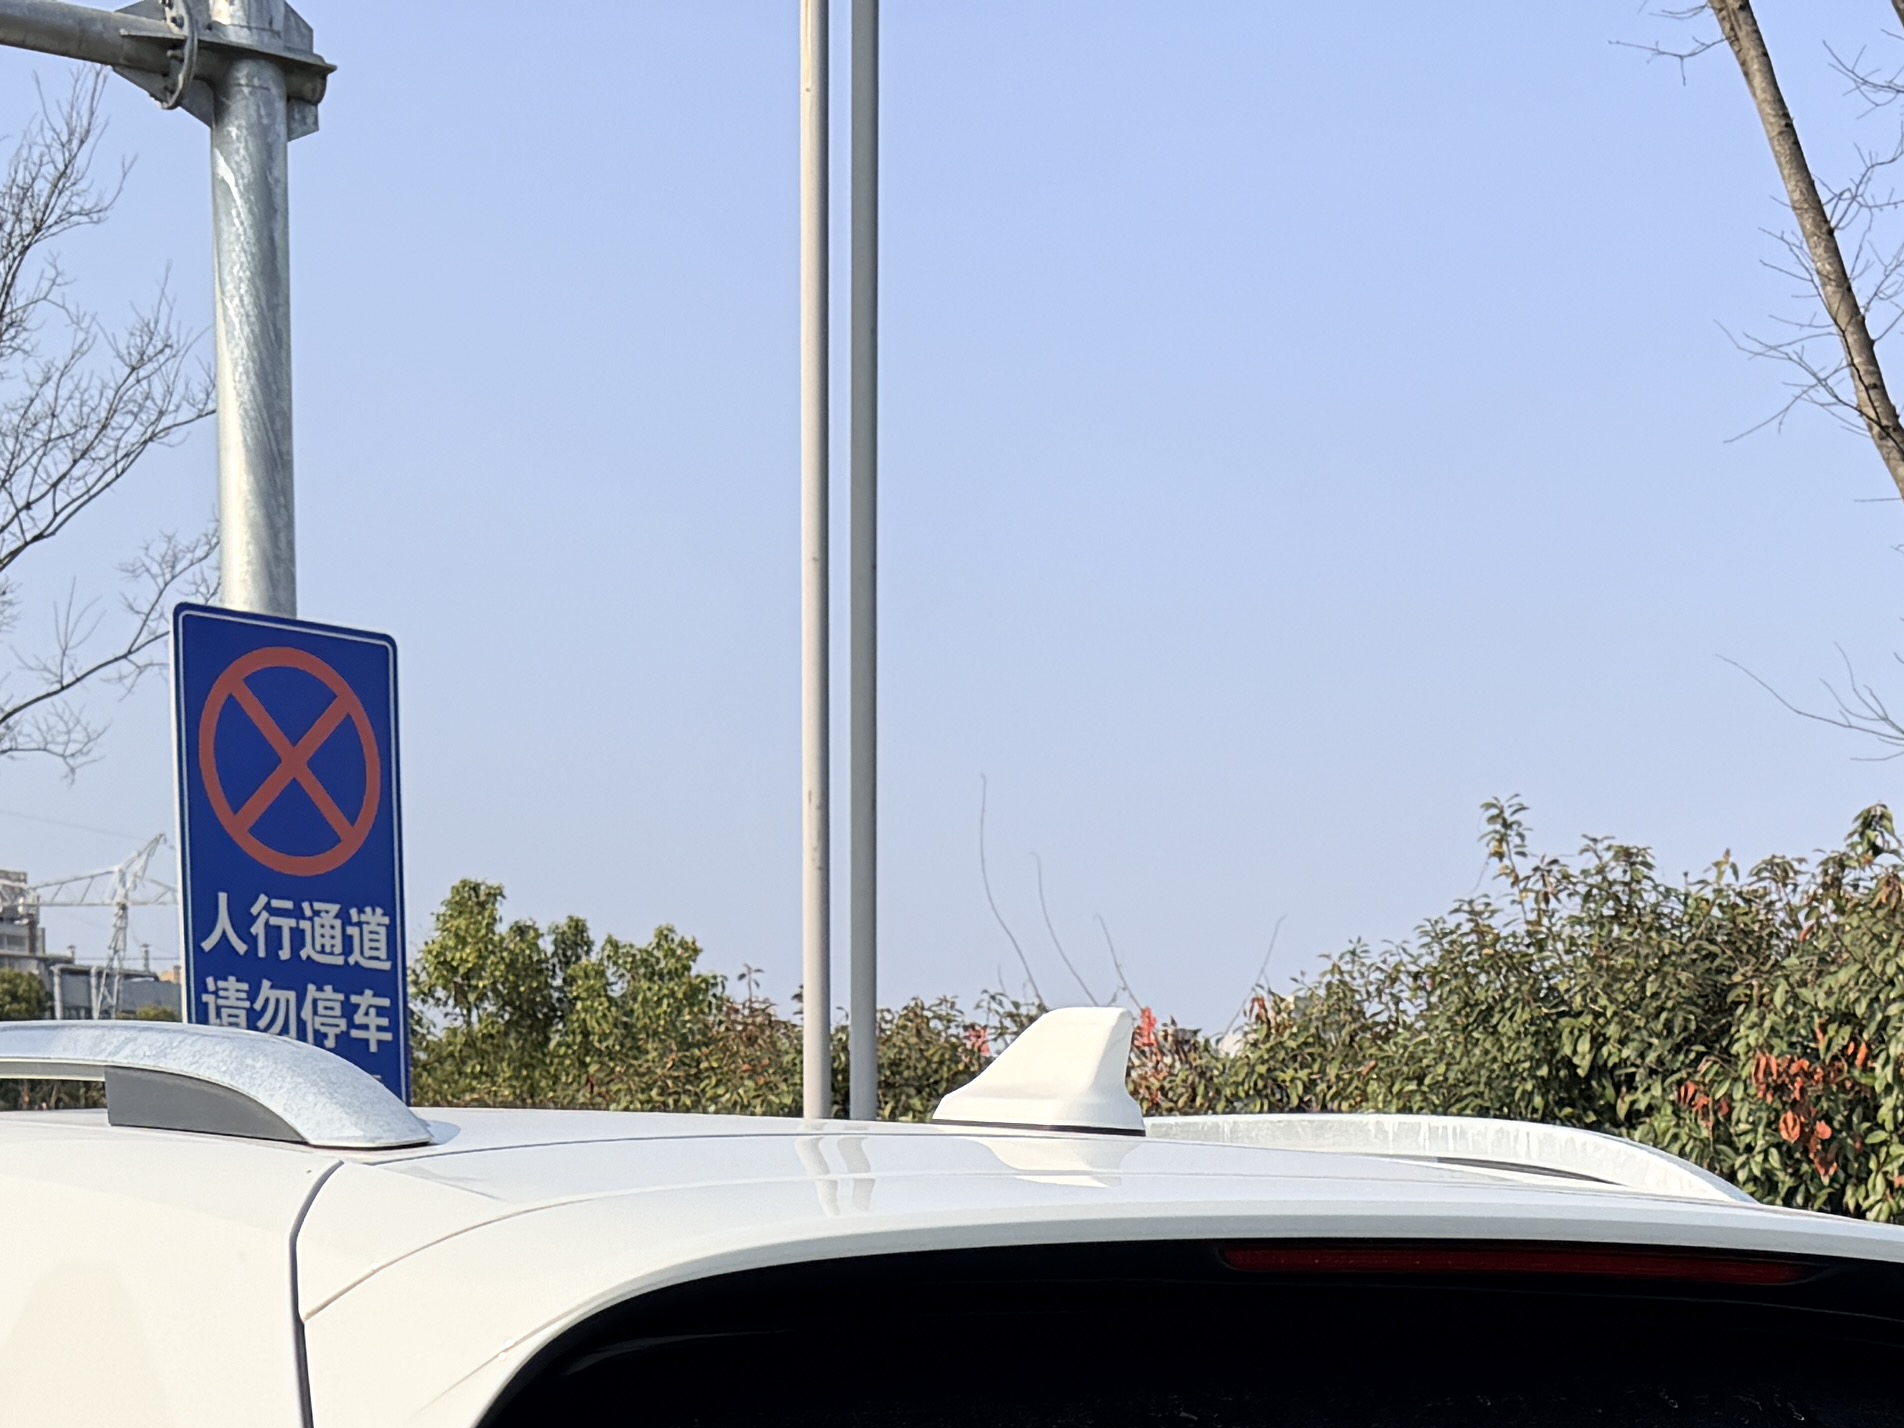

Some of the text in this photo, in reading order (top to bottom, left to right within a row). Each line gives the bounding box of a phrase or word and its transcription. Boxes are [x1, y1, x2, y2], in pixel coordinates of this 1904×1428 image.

[201, 891, 392, 970] 人行通道
[201, 975, 393, 1053] 请勿停车
